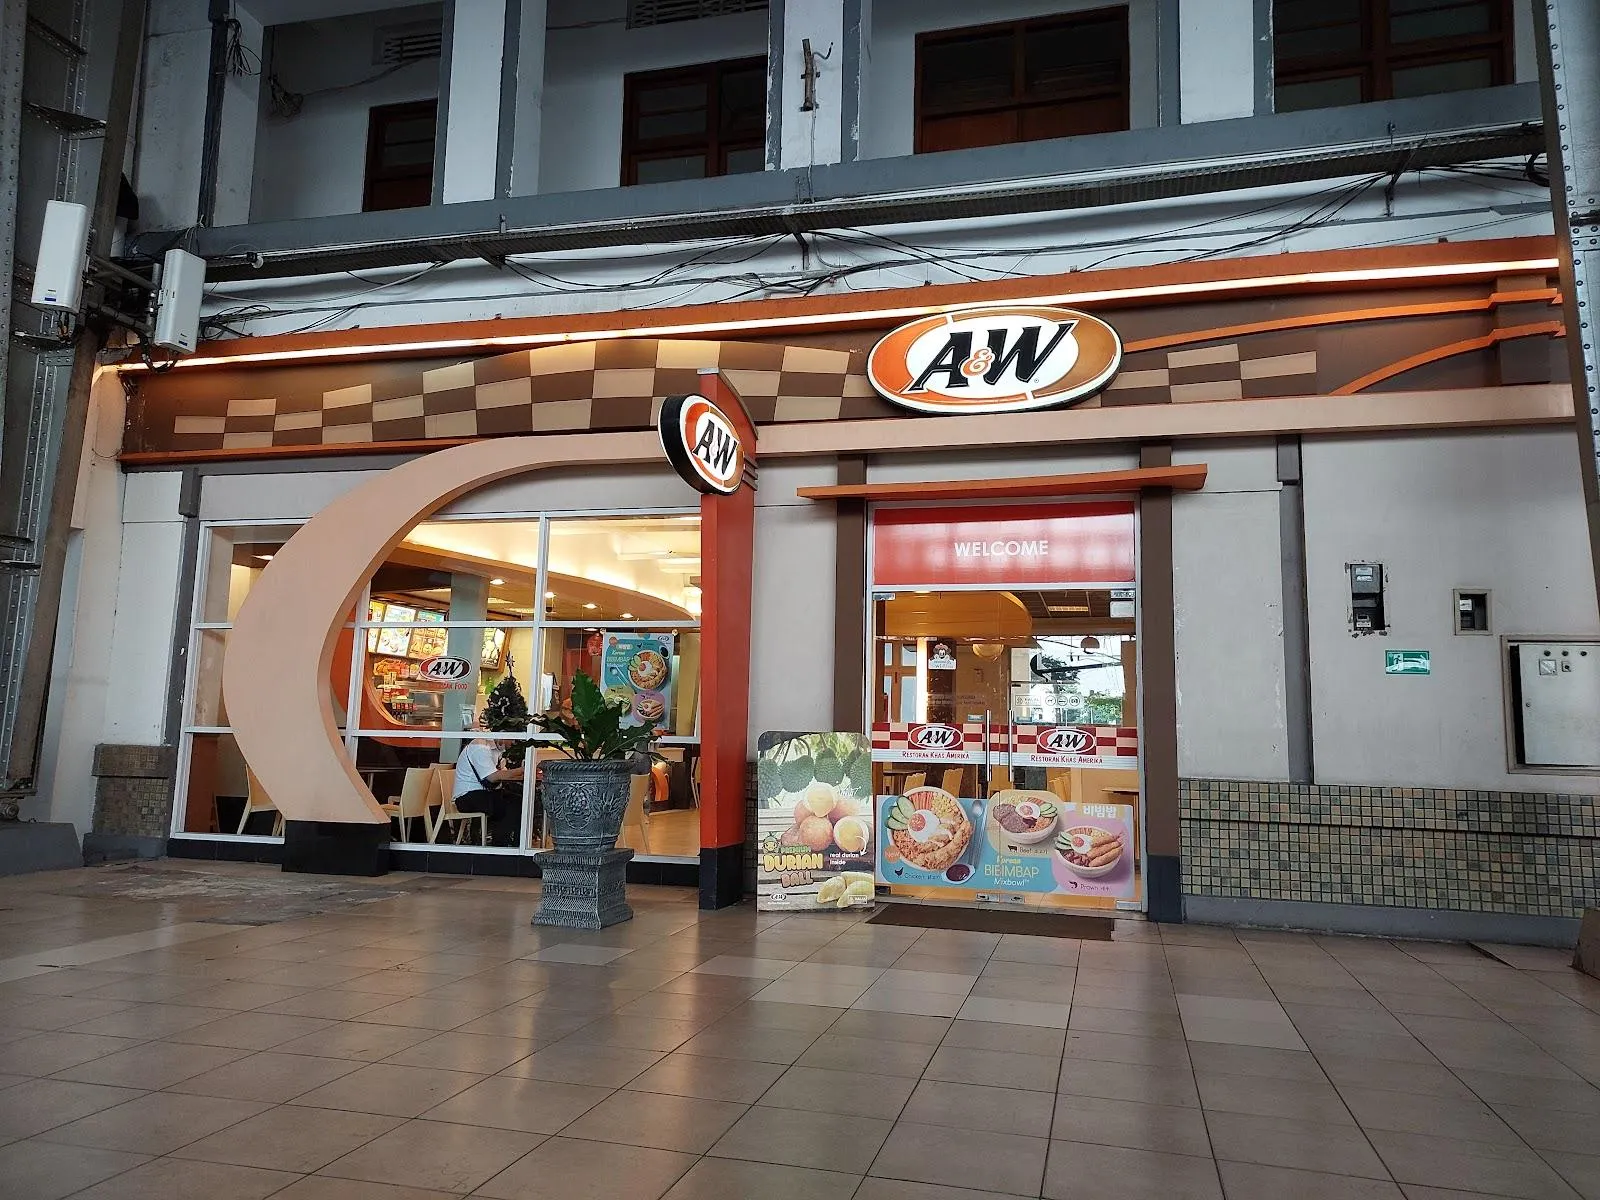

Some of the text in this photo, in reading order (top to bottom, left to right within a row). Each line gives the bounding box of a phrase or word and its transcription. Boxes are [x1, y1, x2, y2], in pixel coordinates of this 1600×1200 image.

[908, 322, 1076, 392] A&W
[954, 540, 1049, 558] WELCOME
[763, 853, 824, 872] DURIAN
[984, 864, 1040, 878] BIBIMBAP
[780, 870, 816, 888] BALL
